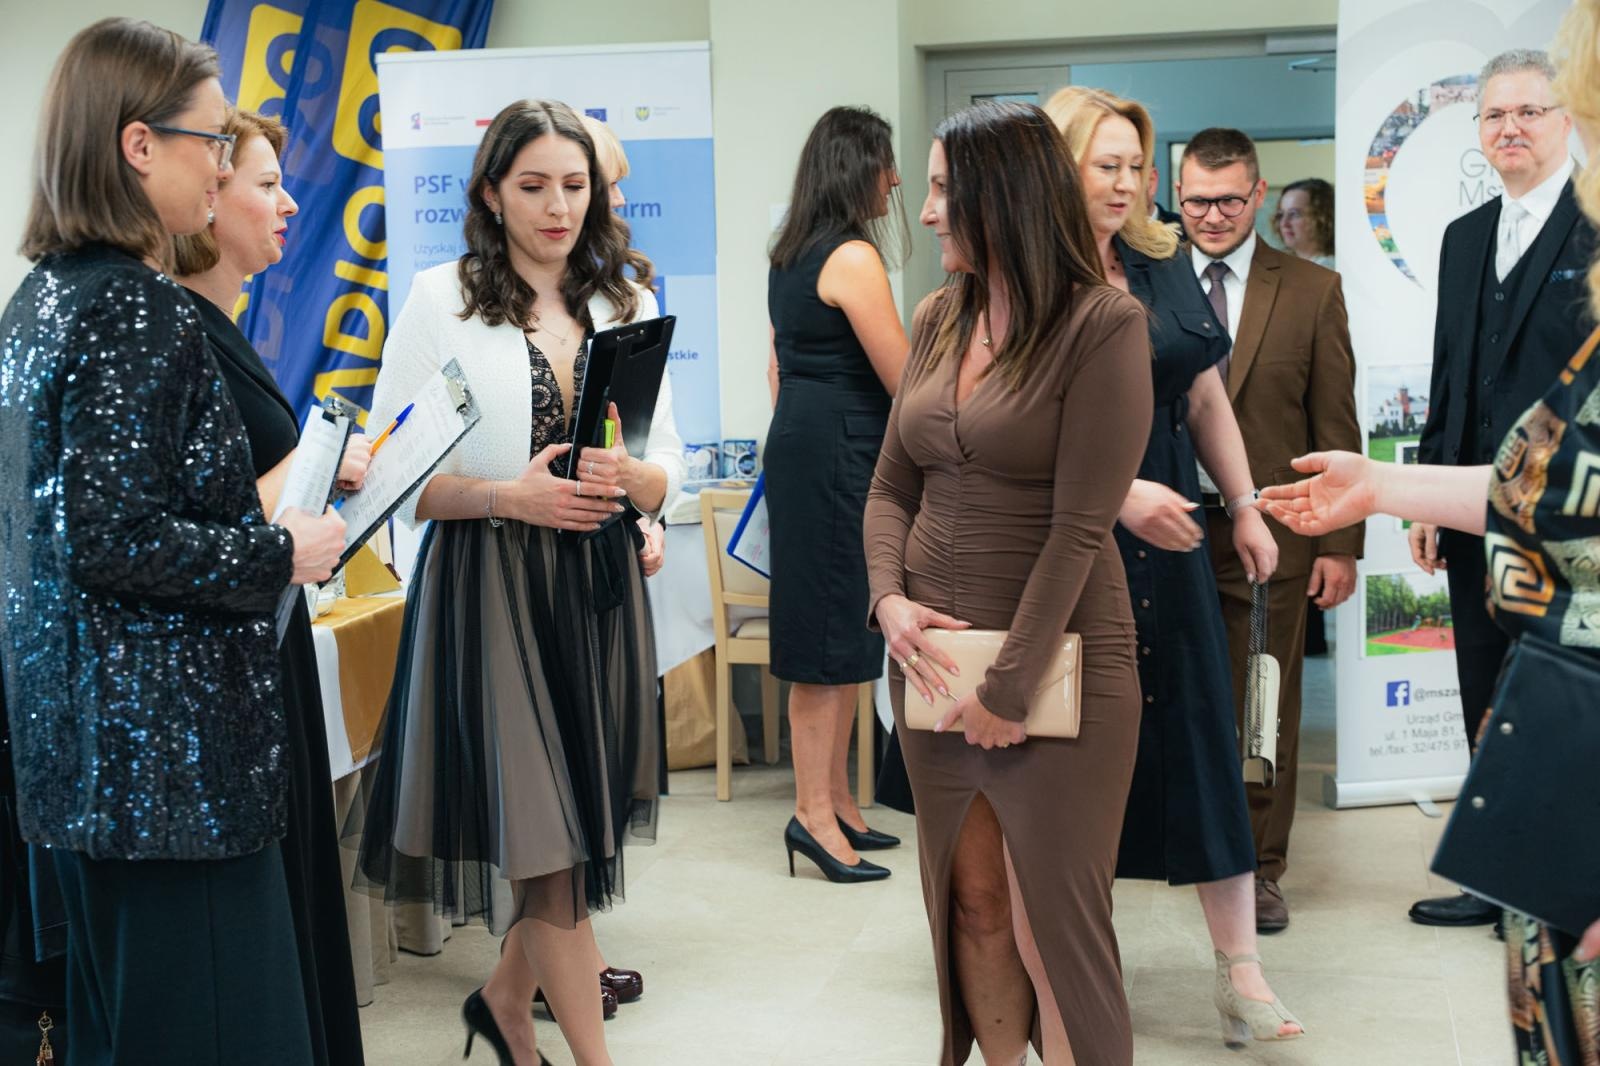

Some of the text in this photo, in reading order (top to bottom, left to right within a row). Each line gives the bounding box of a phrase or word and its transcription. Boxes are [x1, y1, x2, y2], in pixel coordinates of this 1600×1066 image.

[414, 175, 453, 194] PSF
[1459, 179, 1504, 207] Ms
[415, 207, 466, 224] rozw
[622, 198, 662, 218] irm
[313, 185, 389, 430] ADIO
[668, 349, 699, 361] stkie
[1414, 687, 1461, 702] @msza
[1411, 727, 1439, 741] Maja
